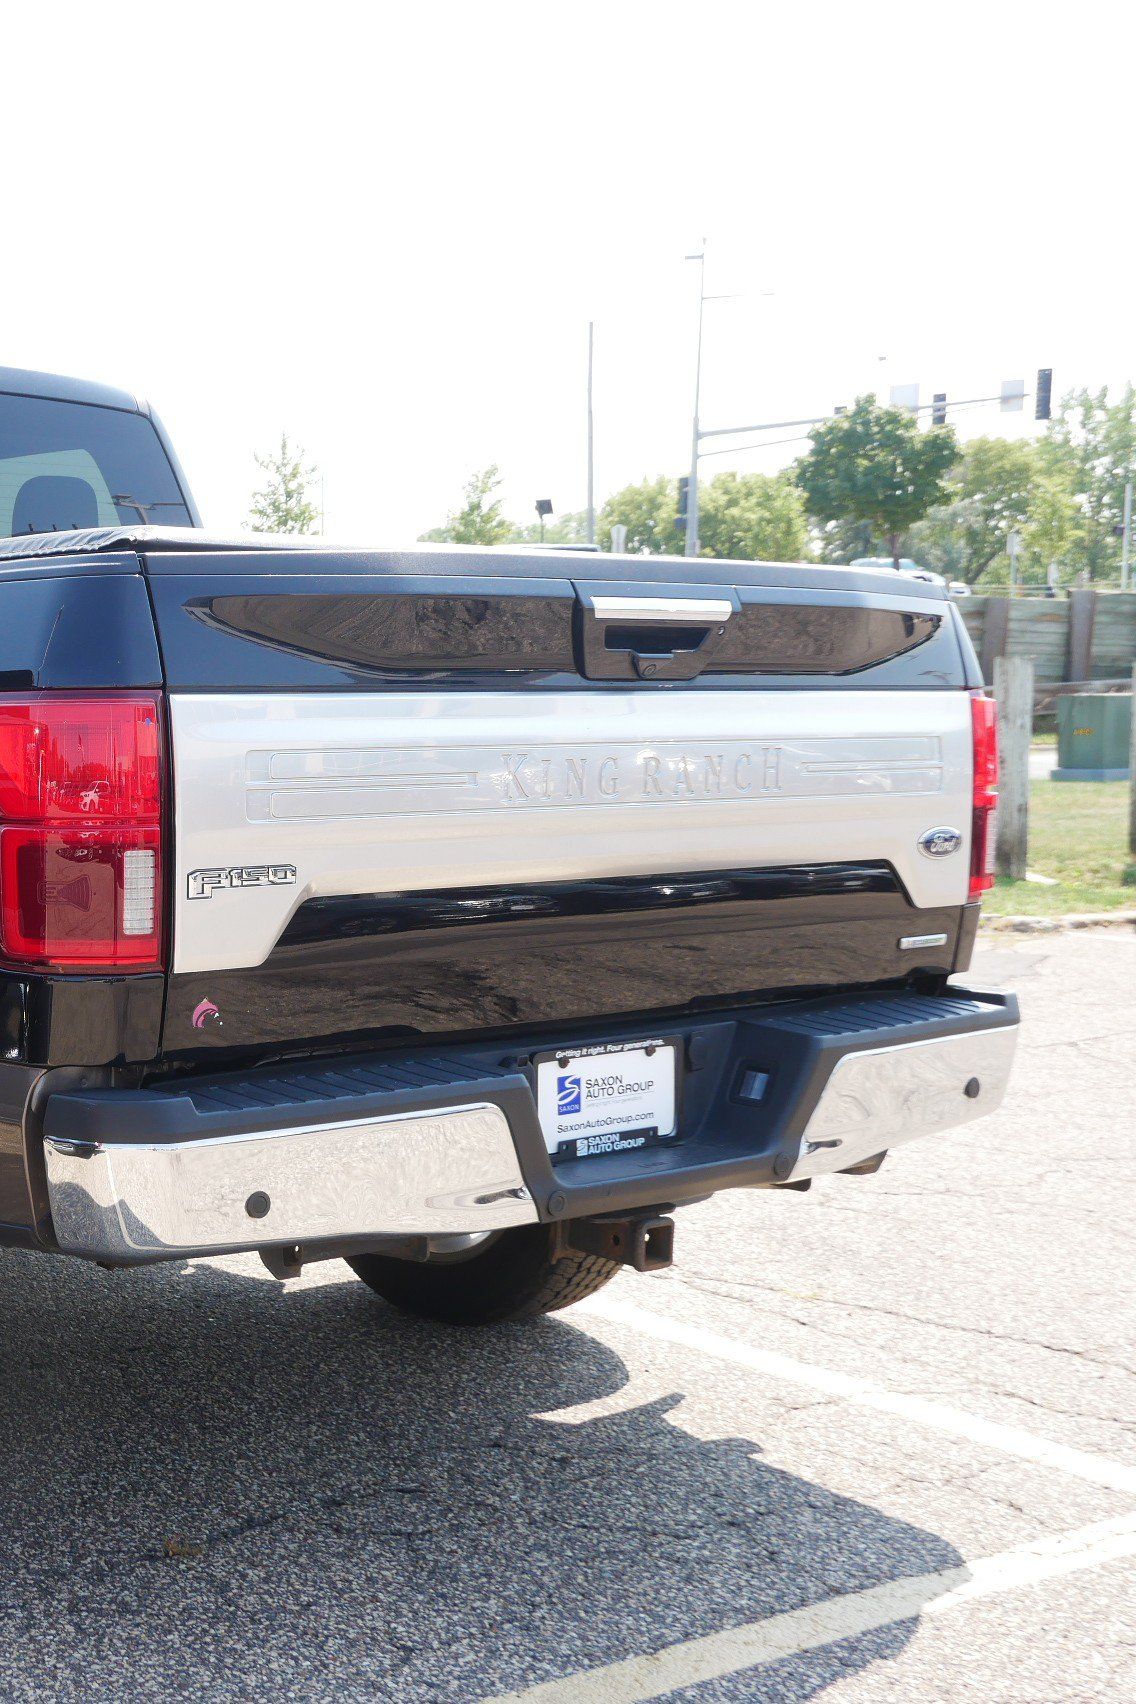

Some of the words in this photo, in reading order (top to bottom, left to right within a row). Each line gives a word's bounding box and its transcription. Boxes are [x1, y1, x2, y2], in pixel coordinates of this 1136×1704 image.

[500, 753, 620, 801] KING
[641, 747, 784, 797] RANCH
[585, 1075, 623, 1089] SAXON
[585, 1086, 615, 1100] AUTO
[617, 1080, 654, 1095] GROUP
[559, 1103, 580, 1112] SAXON
[557, 1112, 655, 1134] SaxonAutoGroup.com
[588, 1133, 620, 1145] SAXON
[588, 1143, 612, 1154] AUTO
[613, 1138, 646, 1150] GROUP
